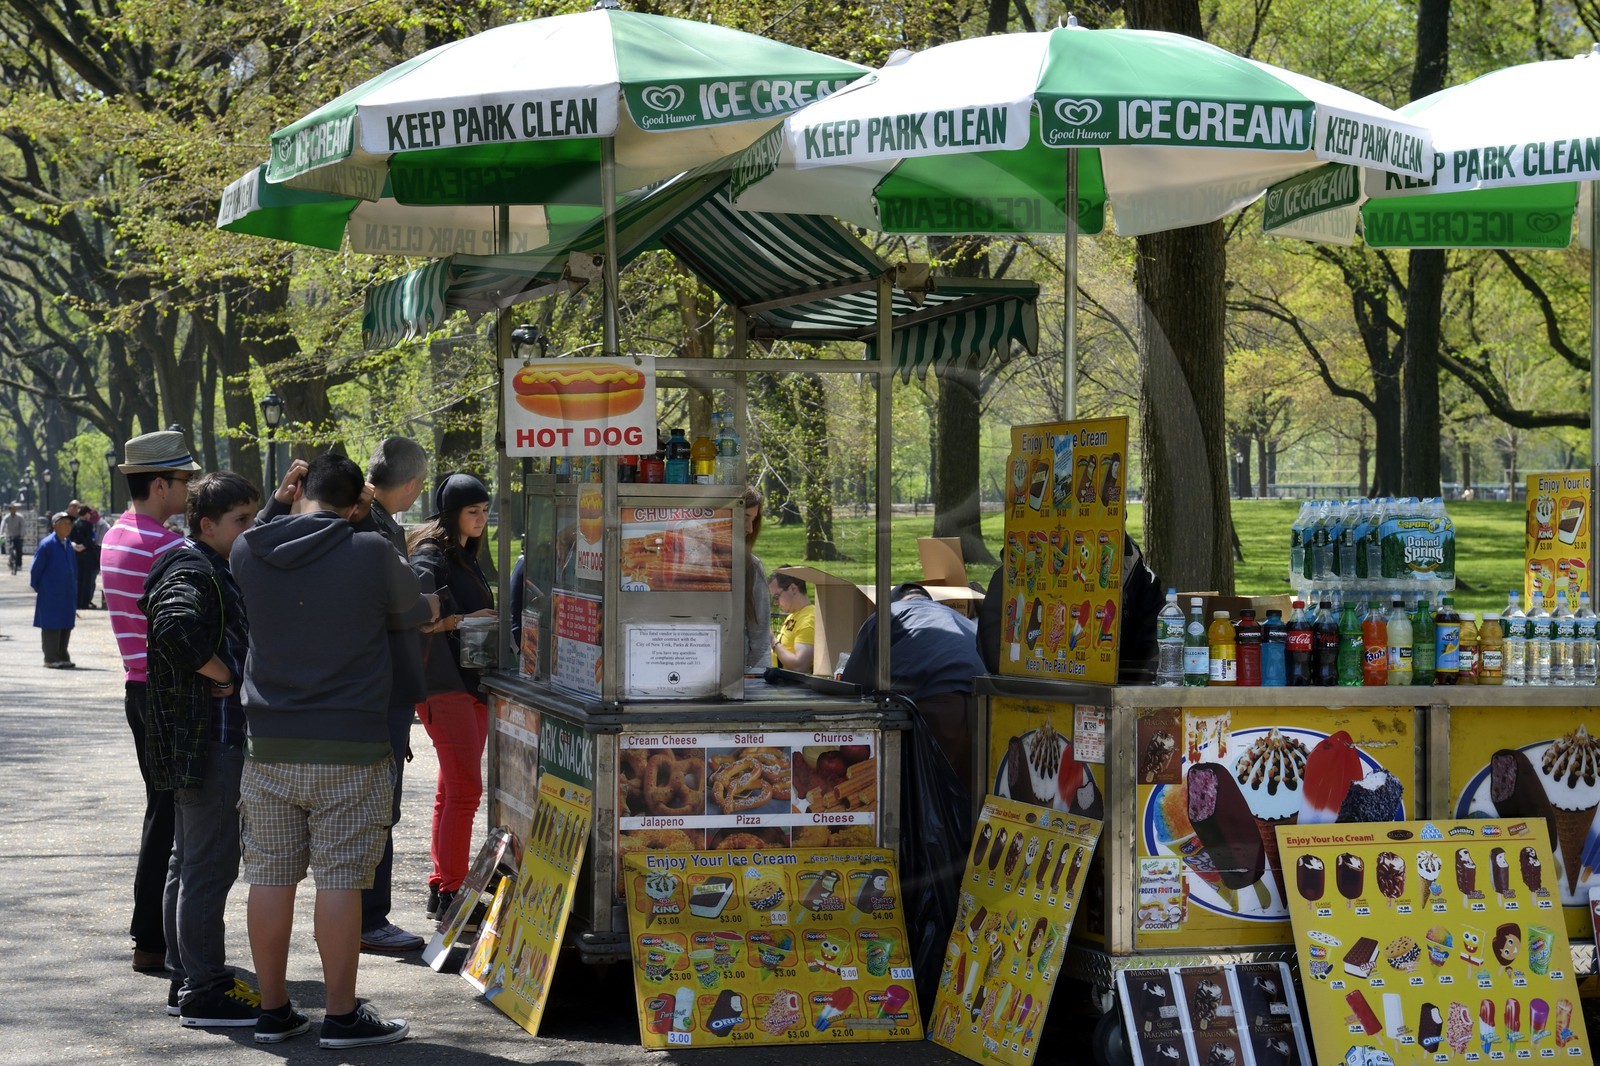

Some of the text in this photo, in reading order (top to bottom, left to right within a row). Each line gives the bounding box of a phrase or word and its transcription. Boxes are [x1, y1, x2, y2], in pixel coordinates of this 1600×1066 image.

[699, 82, 751, 119] ICE
[387, 98, 598, 150] KEEP PARK CLEAN
[642, 113, 697, 129] Good Humor
[1118, 100, 1304, 145] ICE CREAM
[804, 106, 1007, 160] KEEP PARK CLEAN
[1049, 127, 1112, 144] Good Humor
[294, 115, 352, 168] ICE CREAM
[1327, 116, 1424, 174] KEEP PARK CLEAN
[1453, 144, 1516, 185] PARK
[1523, 137, 1600, 178] CLEAN
[1284, 183, 1306, 217] ICE
[1300, 165, 1354, 210] CREAM
[516, 426, 643, 448] HOT DOG
[1022, 434, 1043, 454] Enjoy
[1080, 429, 1108, 447] Cream
[1538, 478, 1560, 494] Enjoy
[1562, 476, 1580, 490] Your
[633, 508, 715, 522] CHURROS
[1407, 536, 1439, 547] Poland
[1404, 546, 1444, 564] Spring
[1482, 653, 1502, 661] Tropican
[1041, 657, 1053, 672] The
[1053, 660, 1068, 673] Park
[1068, 660, 1086, 675] Clean
[628, 735, 698, 746] Cream Cheese
[734, 734, 765, 744] Salted
[813, 732, 854, 743] Churros
[640, 816, 684, 828] Jalapeno
[736, 815, 761, 825] Pizza
[812, 812, 854, 824] Cheese
[1286, 834, 1374, 845] Enjoy Your Ice Cream!
[647, 855, 686, 870] Enjoy
[691, 854, 723, 867] Your
[728, 853, 748, 865] Ice
[752, 852, 797, 865] Cream
[652, 905, 680, 914] KING
[658, 917, 680, 925] $3.00
[720, 915, 742, 923] $3.00
[771, 913, 787, 921] 3.00
[811, 913, 833, 921] $4.00
[872, 912, 894, 920] $4.00
[669, 973, 691, 981] $3.00
[724, 971, 745, 979] $3.00
[842, 970, 857, 978] 3.00
[893, 970, 912, 978] 3.00
[711, 1017, 744, 1028] OREO
[732, 1032, 754, 1040] $3.00
[788, 1030, 810, 1038] $3.00
[832, 1029, 854, 1037] $2.00
[888, 1028, 910, 1036] $2.00
[1144, 1029, 1178, 1039] MAGNUM
[1201, 1030, 1233, 1038] MAGNUM
[670, 1033, 690, 1043] 3.00
[1423, 1036, 1443, 1045] OREO
